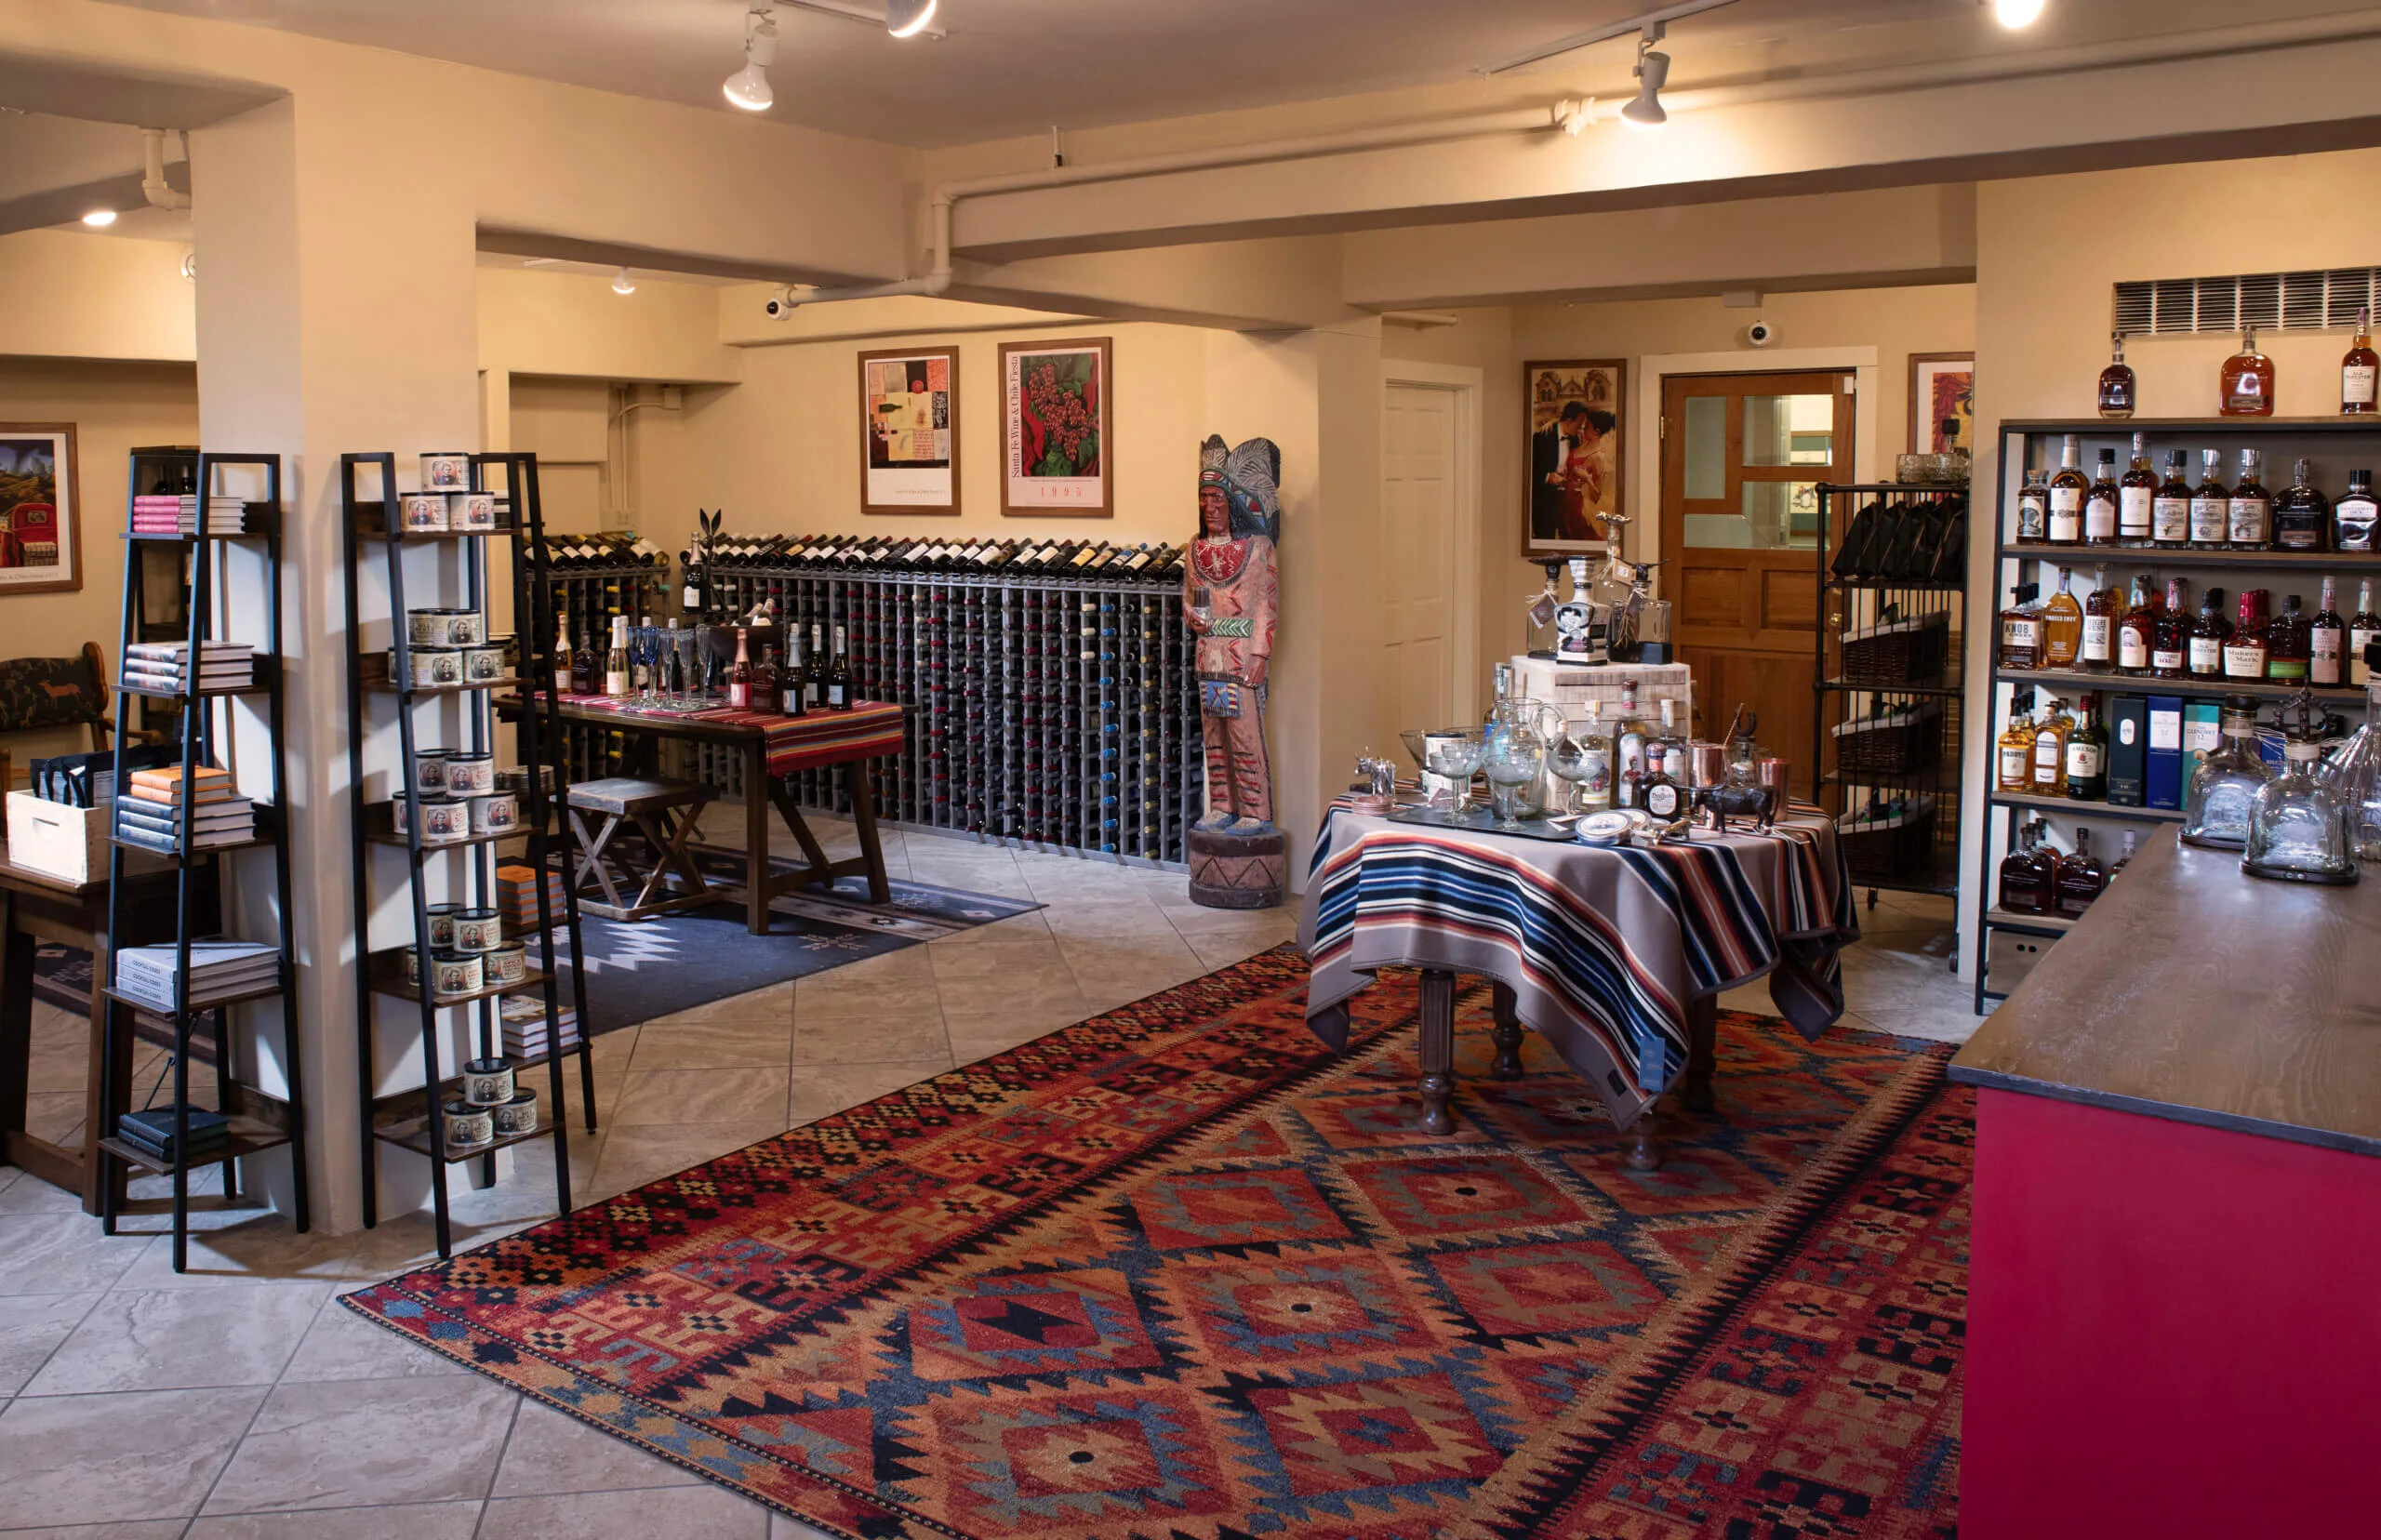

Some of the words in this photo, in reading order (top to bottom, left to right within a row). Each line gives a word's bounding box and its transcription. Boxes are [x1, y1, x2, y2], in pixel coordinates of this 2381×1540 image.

[1010, 356, 1019, 381] Fiesta
[1011, 385, 1020, 405] Chile
[1012, 406, 1020, 415] &
[1011, 418, 1020, 438] Wine
[1012, 439, 1020, 450] Fe
[1012, 453, 1020, 478] Santa
[2005, 623, 2029, 633] KNOB
